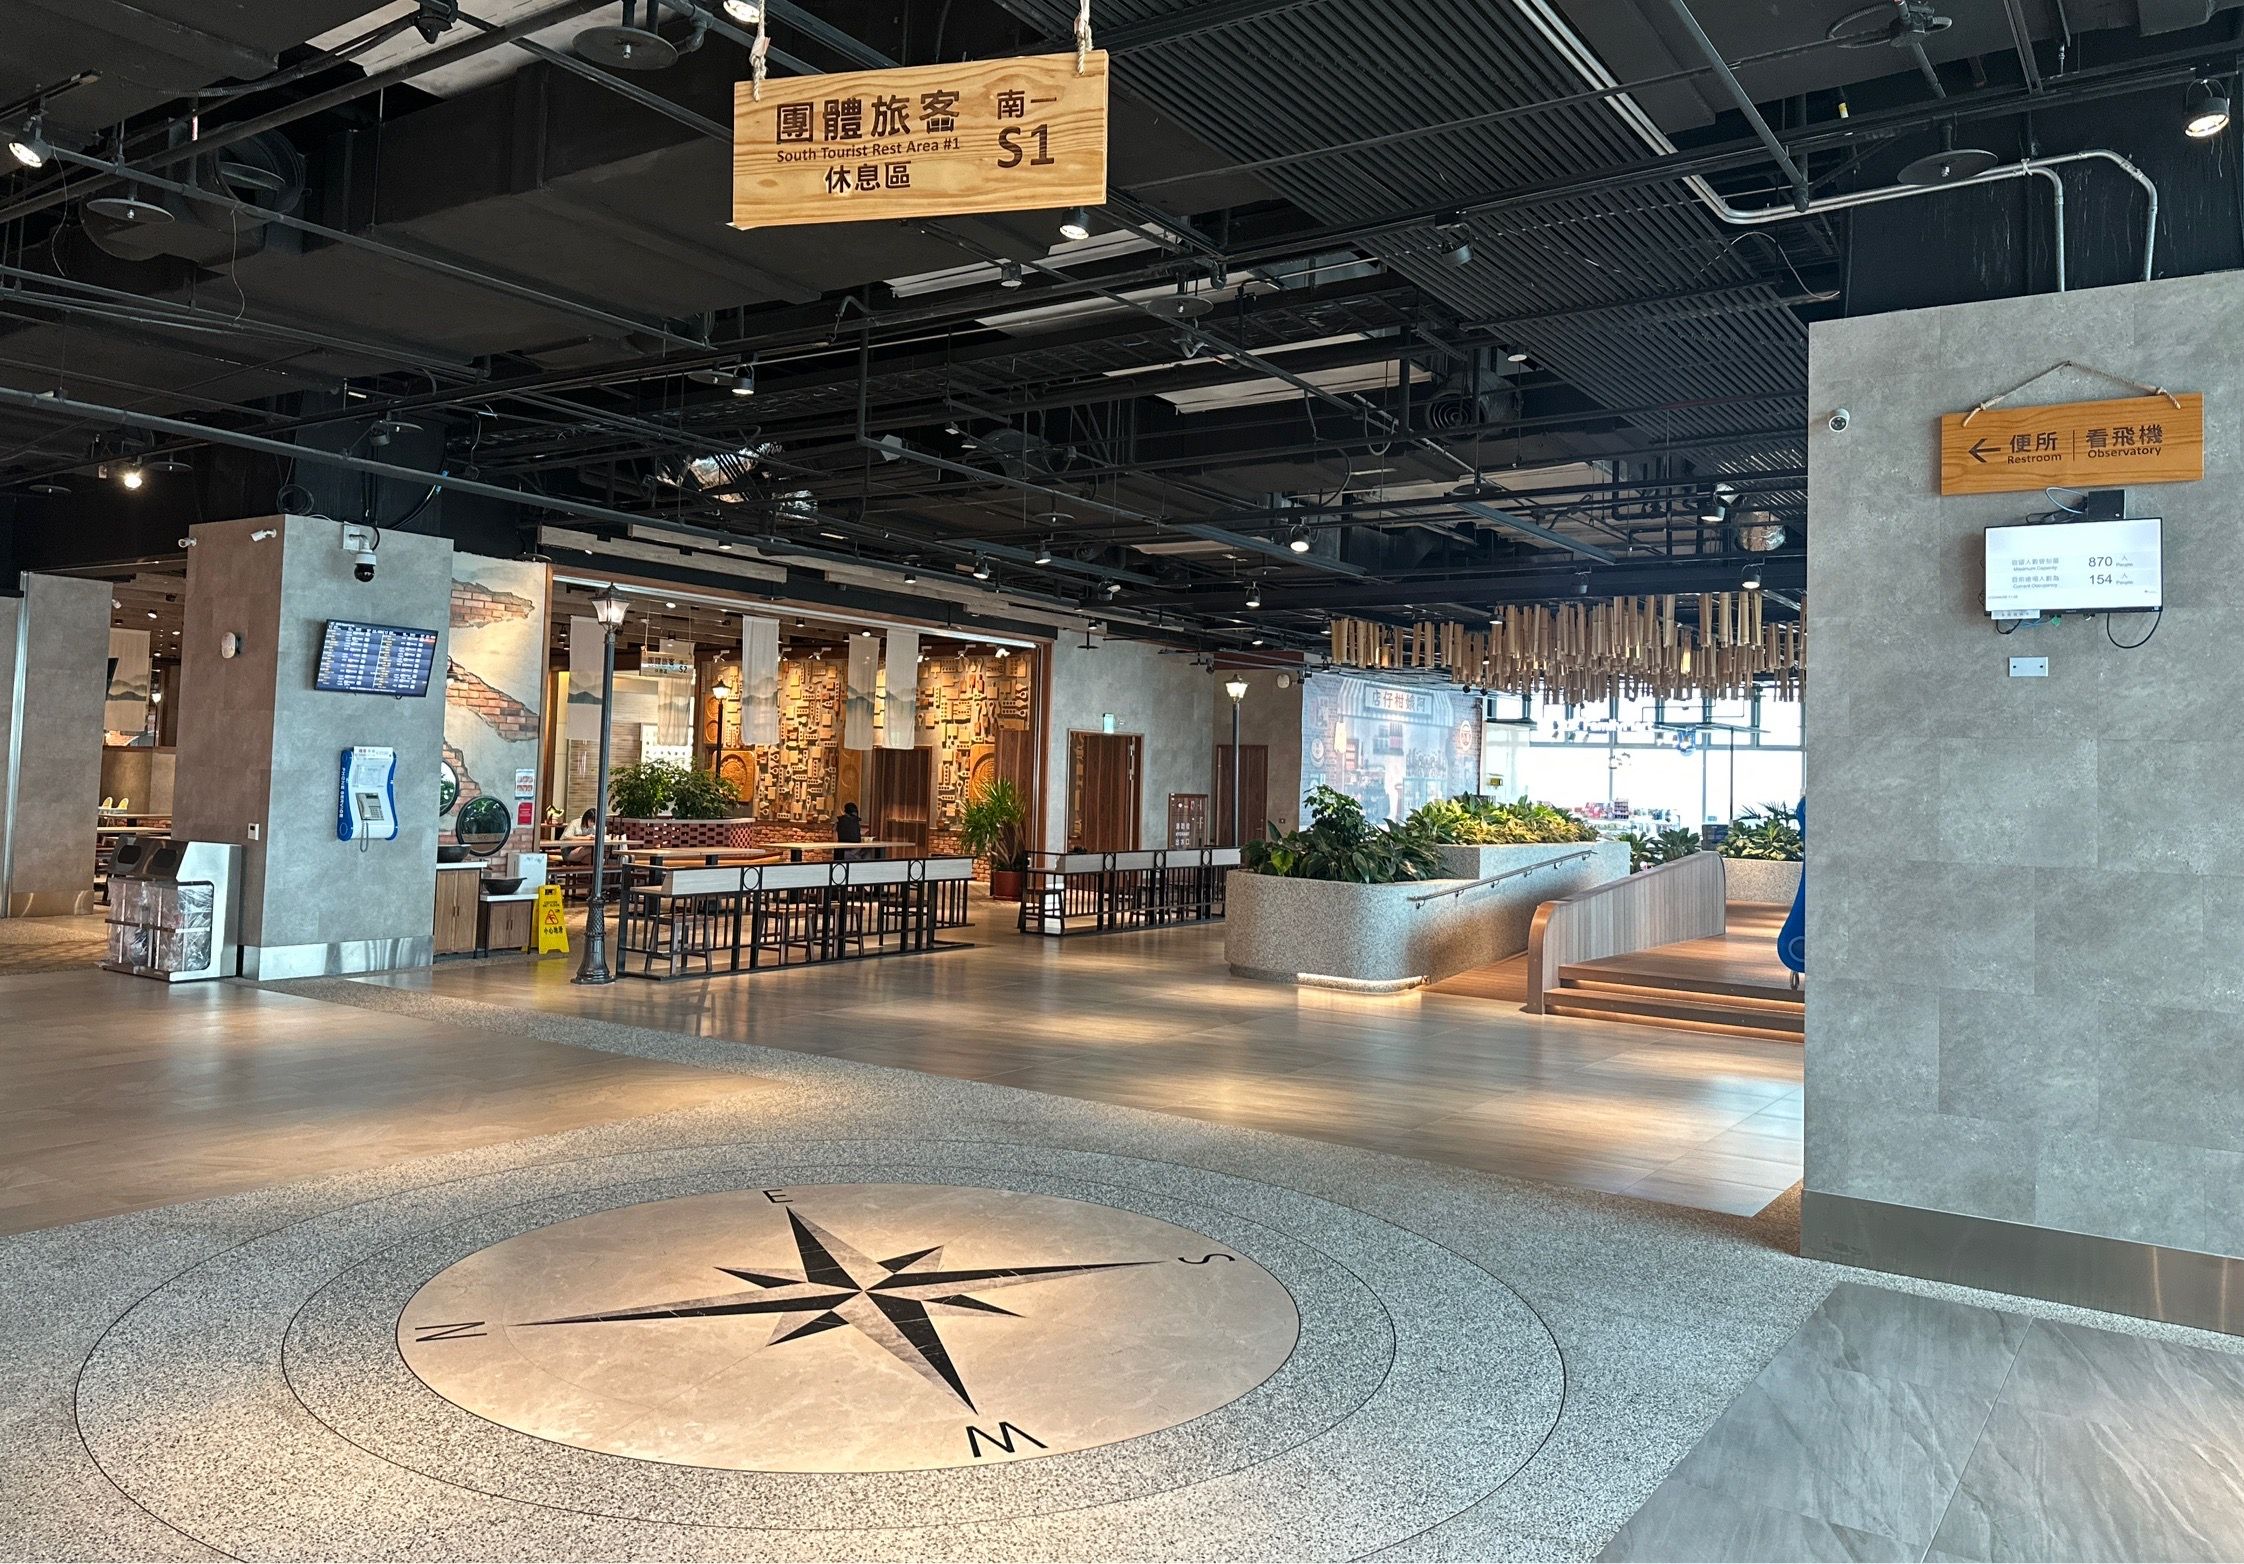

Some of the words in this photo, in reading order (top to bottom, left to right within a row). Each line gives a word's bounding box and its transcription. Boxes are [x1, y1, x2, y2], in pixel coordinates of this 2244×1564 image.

[997, 89, 1057, 120] 南一
[776, 89, 960, 145] 團體旅客
[777, 148, 816, 163] South
[820, 144, 868, 160] Tourist
[872, 142, 902, 156] Rest
[906, 140, 939, 153] Area
[943, 137, 960, 150] #1
[997, 124, 1055, 168] S1
[825, 161, 911, 194] 休息區
[2009, 431, 2058, 454] 便所
[2085, 424, 2163, 448] 看飛機
[2007, 453, 2062, 464] Restroom
[2087, 445, 2162, 459] Observatory
[2088, 556, 2113, 567] 870
[2089, 574, 2113, 585] 154
[680, 665, 688, 673] S2
[762, 1189, 794, 1203] E
[1178, 1253, 1236, 1265] S
[415, 1321, 487, 1342] N
[966, 1421, 1049, 1458] W
